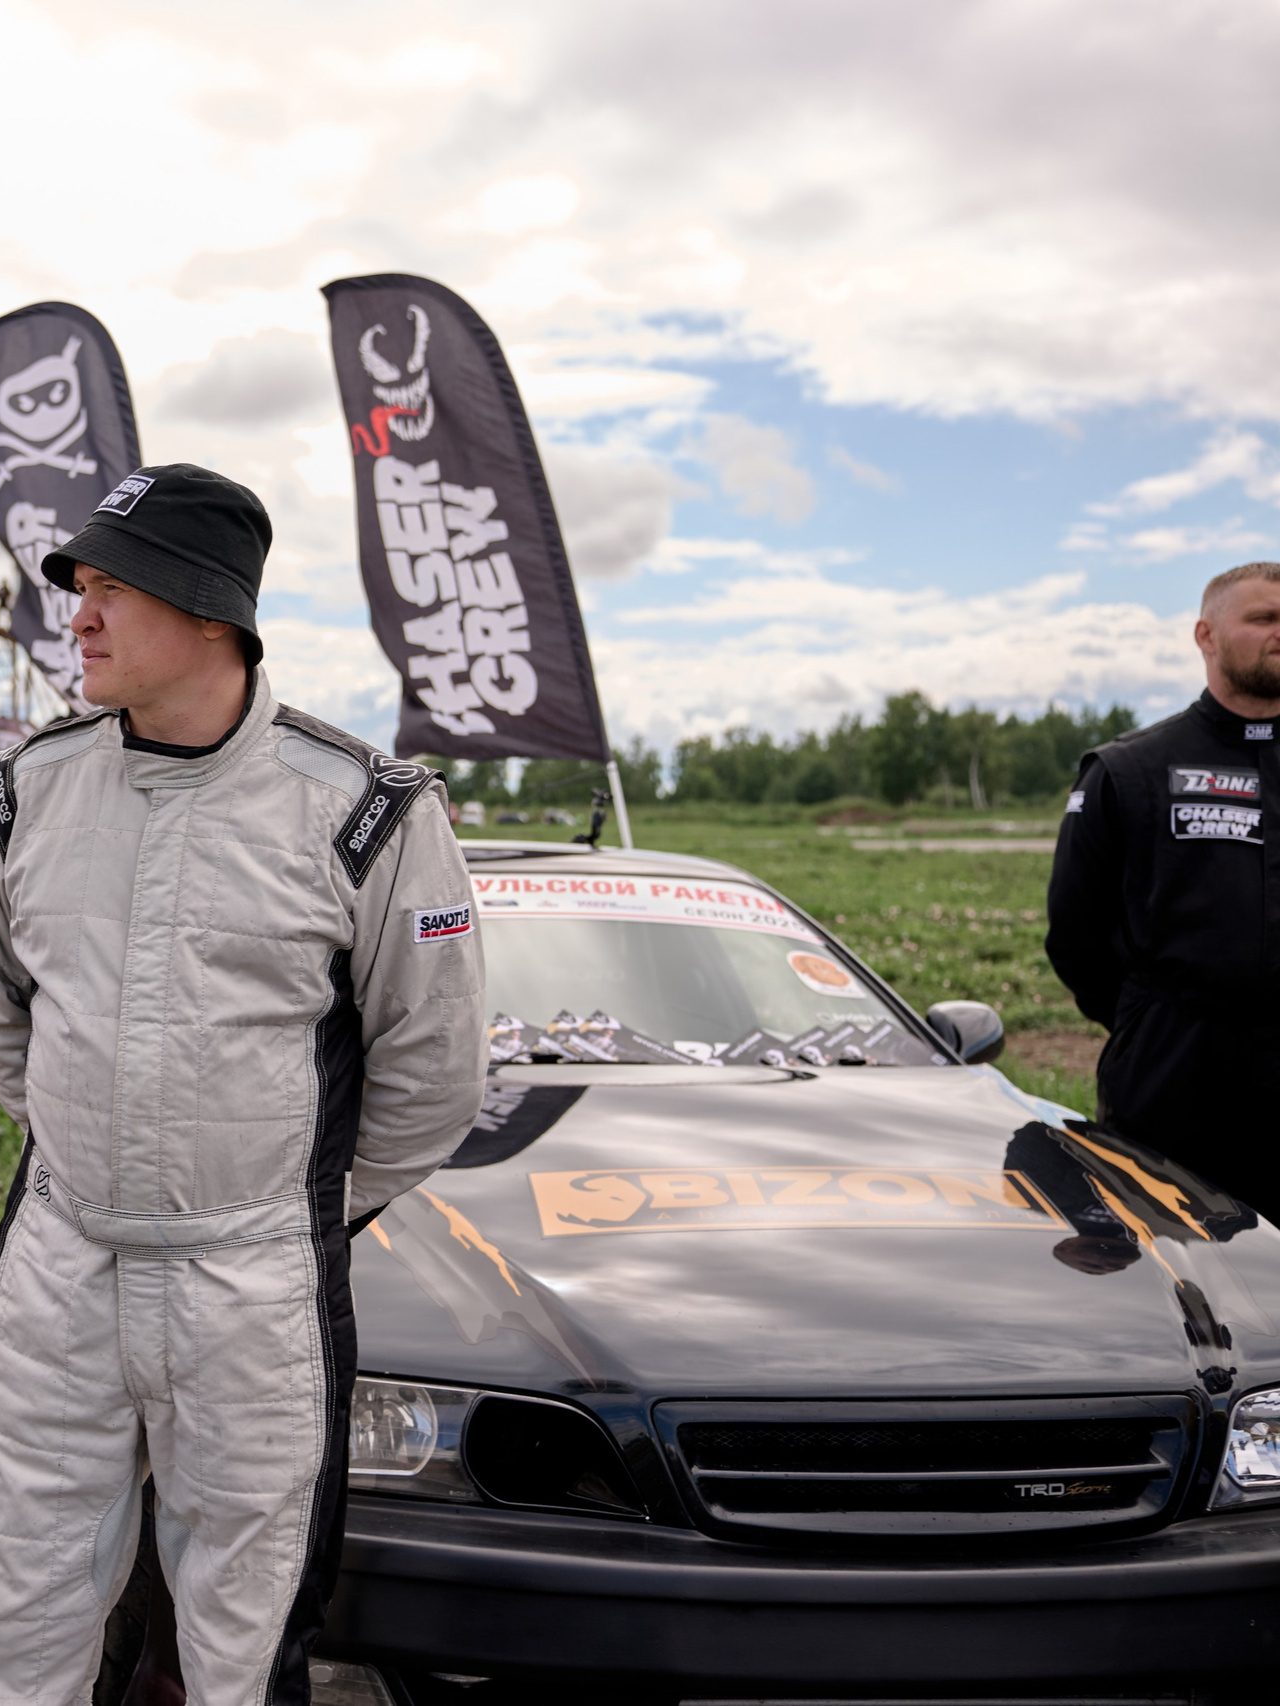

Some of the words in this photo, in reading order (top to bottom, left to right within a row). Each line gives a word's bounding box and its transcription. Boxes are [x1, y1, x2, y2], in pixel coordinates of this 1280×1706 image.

[111, 479, 147, 496] SER
[440, 482, 538, 716] CREW
[1245, 724, 1274, 740] OMP
[348, 795, 388, 852] sparco
[1177, 807, 1261, 827] CHASER
[1186, 821, 1252, 837] CREW
[474, 879, 637, 896] УЛЬСКОЙ
[420, 908, 469, 932] SANDTLE
[684, 907, 744, 922] СЕЗОН
[639, 1171, 1032, 1209] BIZON
[1014, 1483, 1065, 1497] TRD
